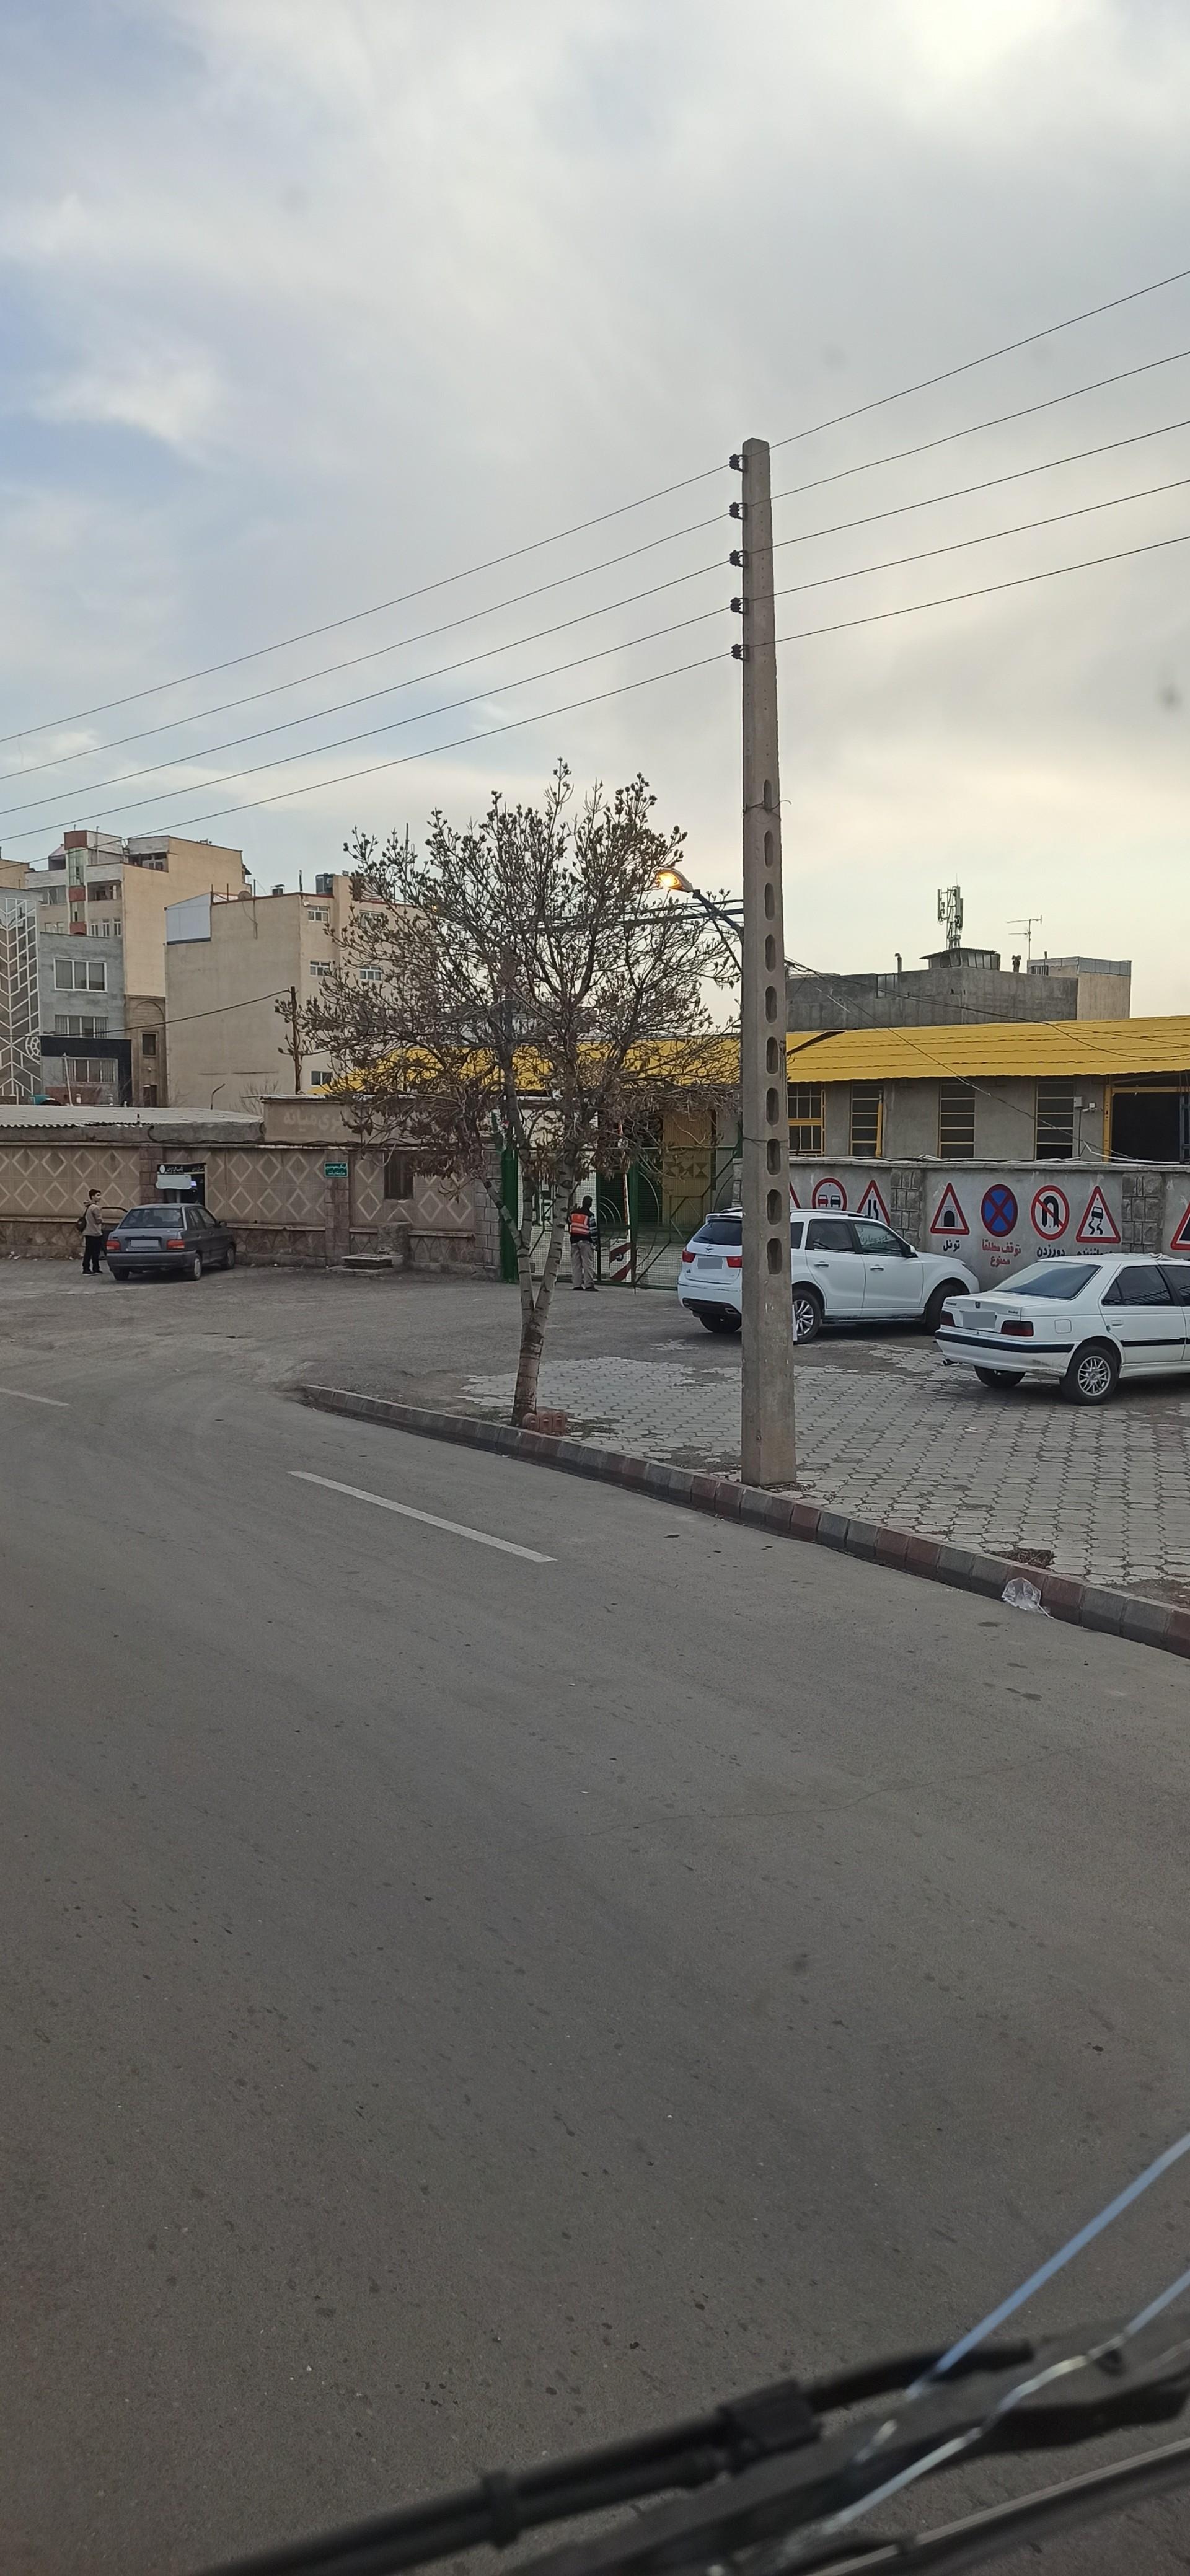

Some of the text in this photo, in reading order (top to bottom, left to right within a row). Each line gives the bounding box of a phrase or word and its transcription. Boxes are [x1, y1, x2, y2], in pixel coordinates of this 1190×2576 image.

[283, 1108, 317, 1132] میانه
[943, 1240, 960, 1252] تونل
[1002, 1242, 1021, 1257] توقف
[990, 1255, 1011, 1267] ممنوع
